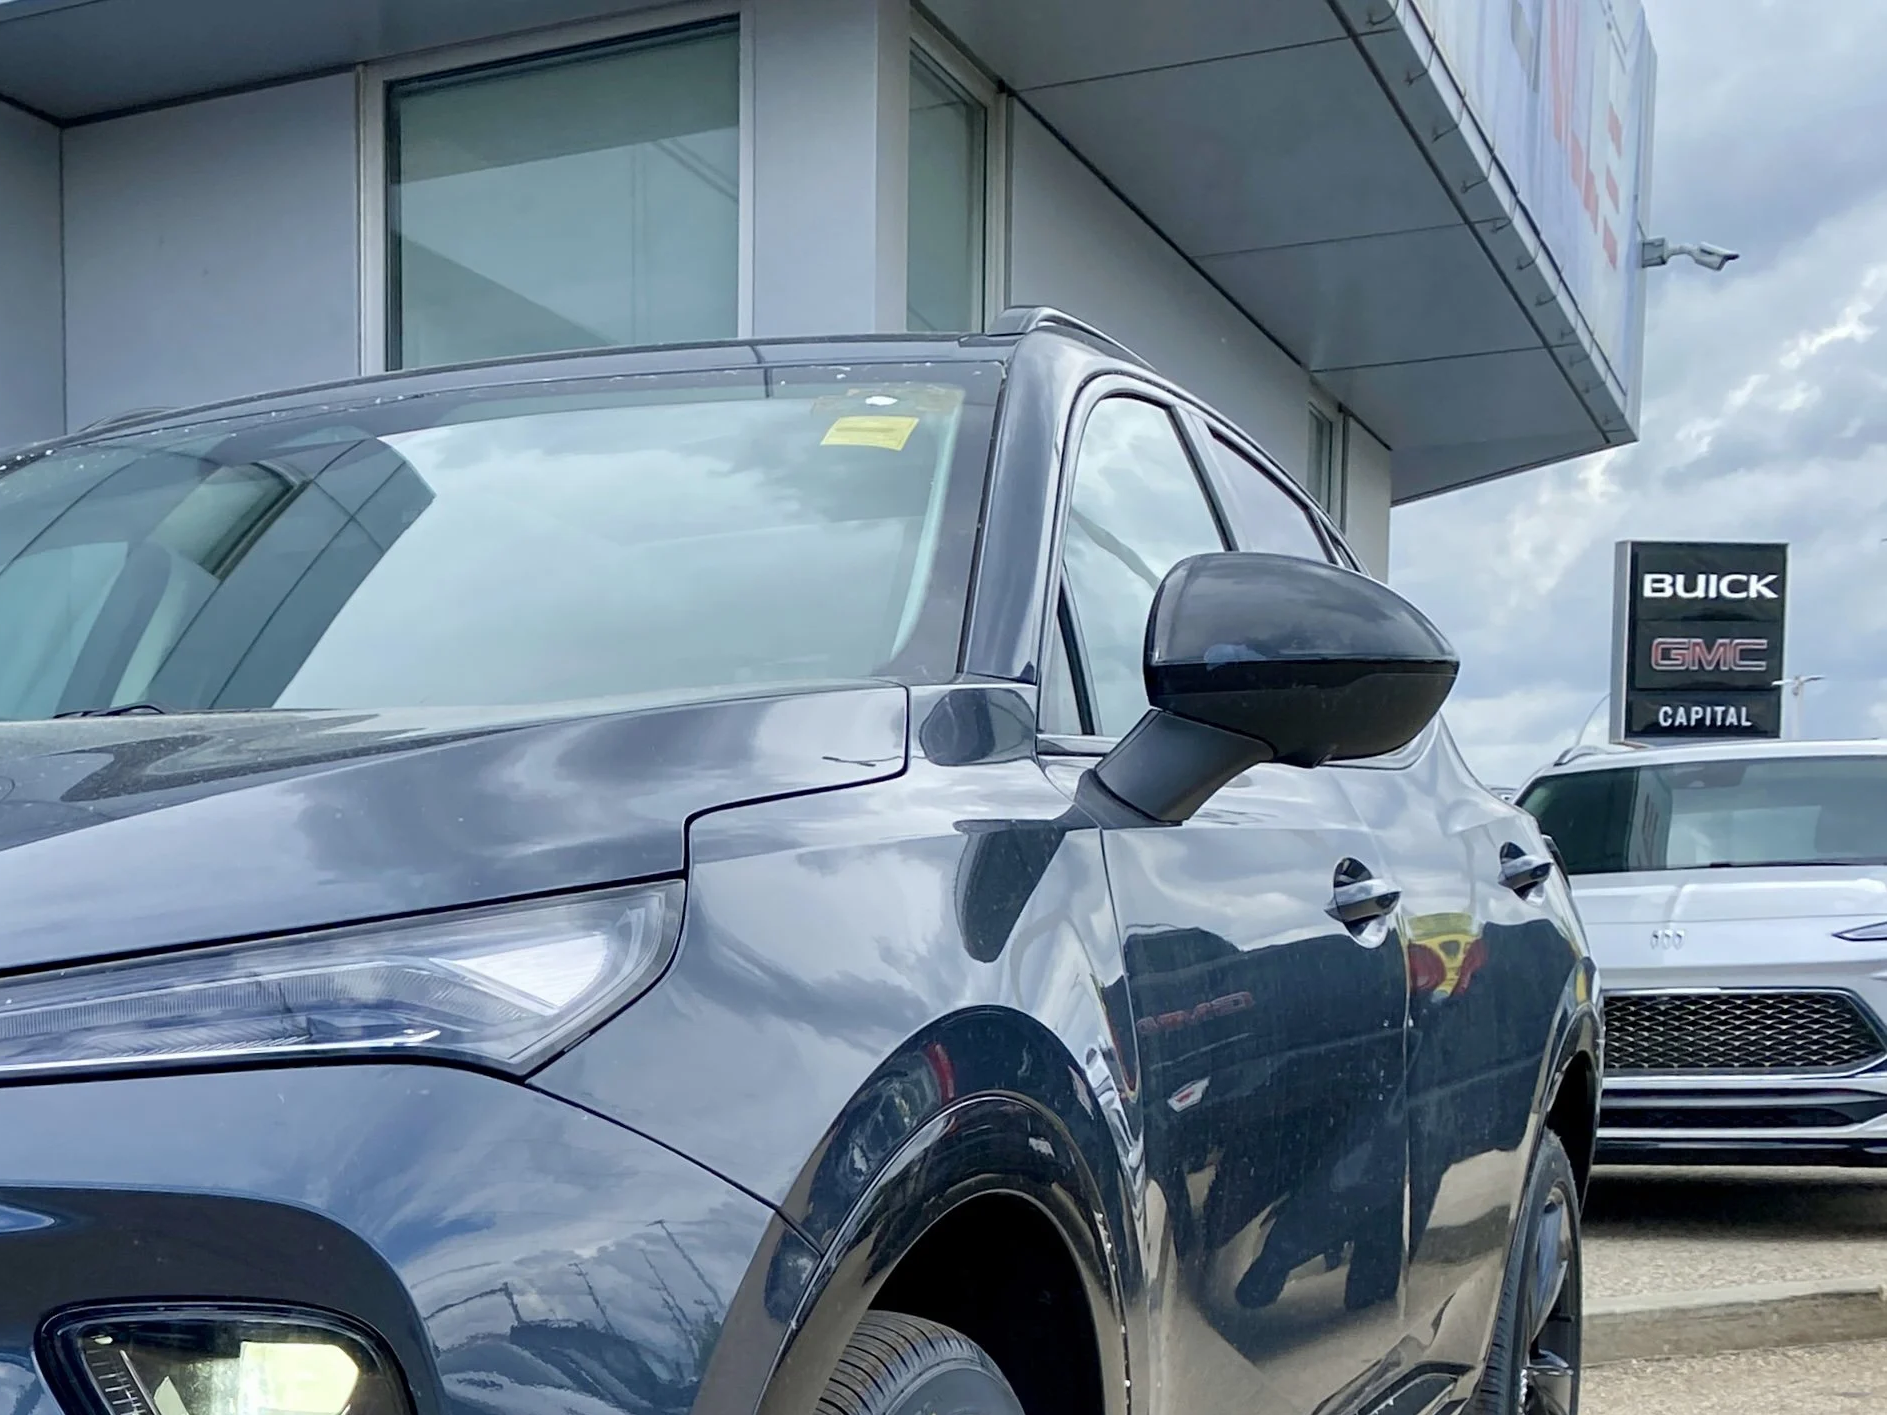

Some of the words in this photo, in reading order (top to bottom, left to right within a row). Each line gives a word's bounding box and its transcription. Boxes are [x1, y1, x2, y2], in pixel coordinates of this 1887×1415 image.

[1643, 573, 1779, 598] BUICK
[1651, 638, 1768, 671] GMC
[1658, 705, 1752, 728] CAPITAL
